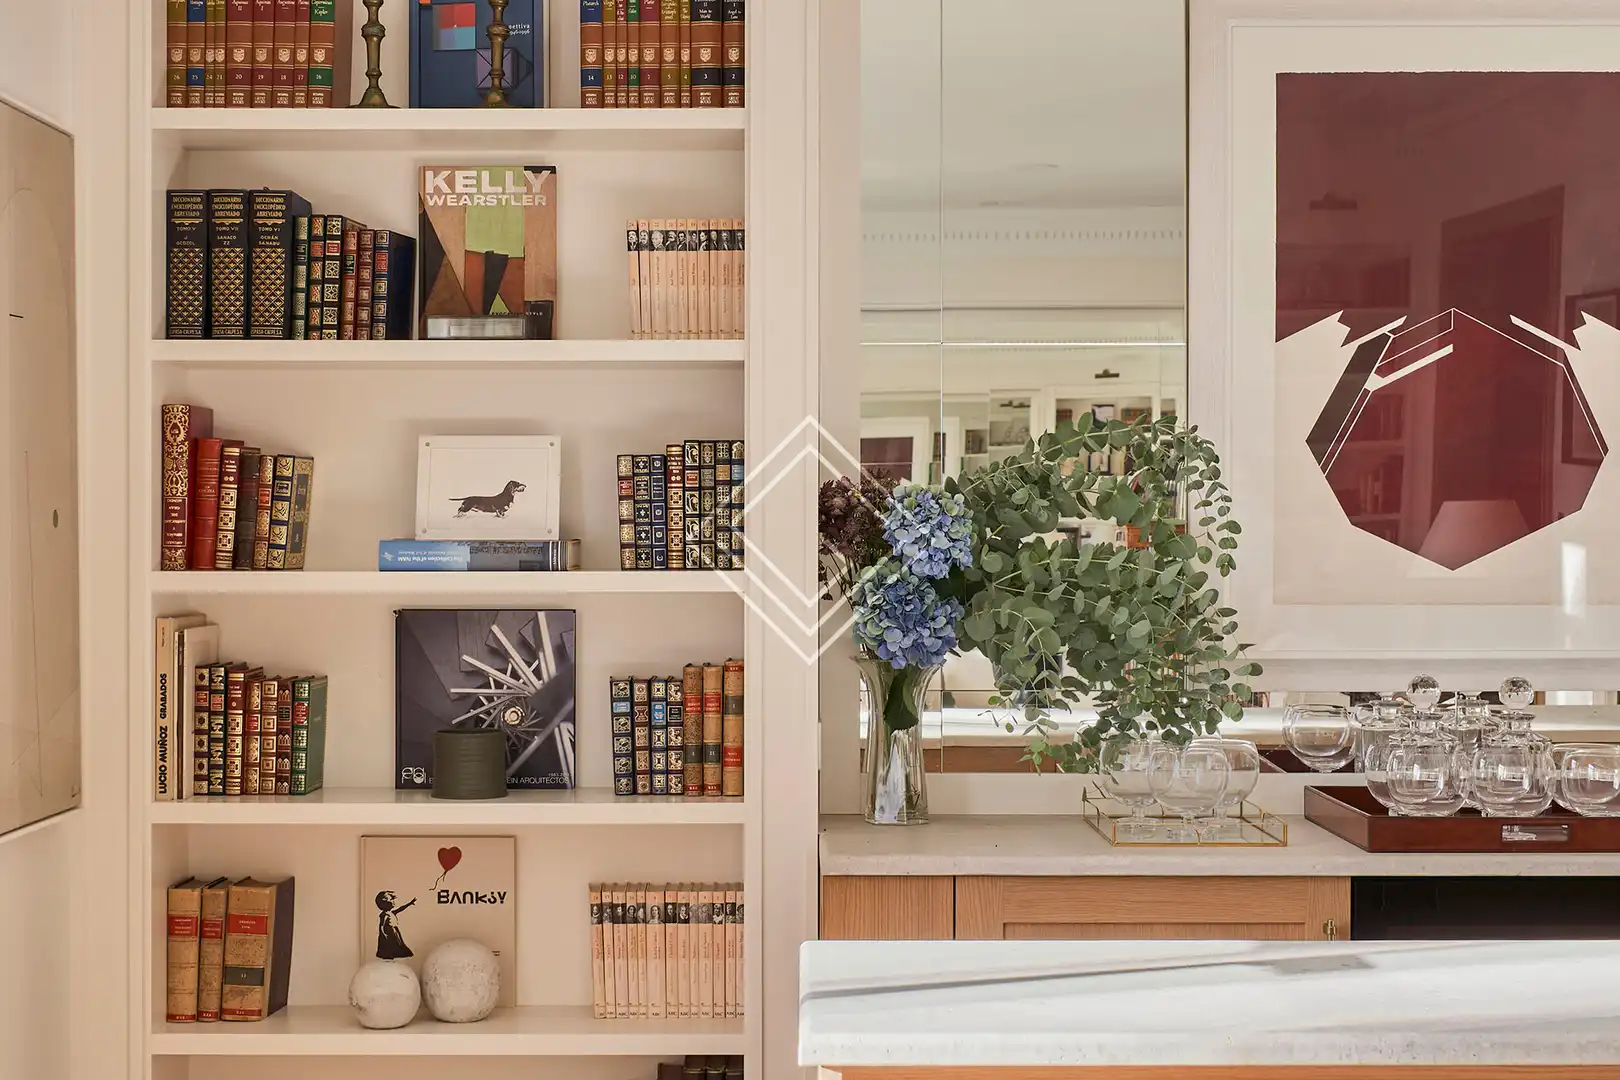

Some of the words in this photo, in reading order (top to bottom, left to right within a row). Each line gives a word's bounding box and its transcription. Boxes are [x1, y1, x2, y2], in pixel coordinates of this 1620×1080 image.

[425, 170, 551, 194] KELLY
[426, 194, 546, 206] WEARSTLER
[159, 726, 168, 762] MUÑOZ
[159, 765, 167, 794] LUCIO
